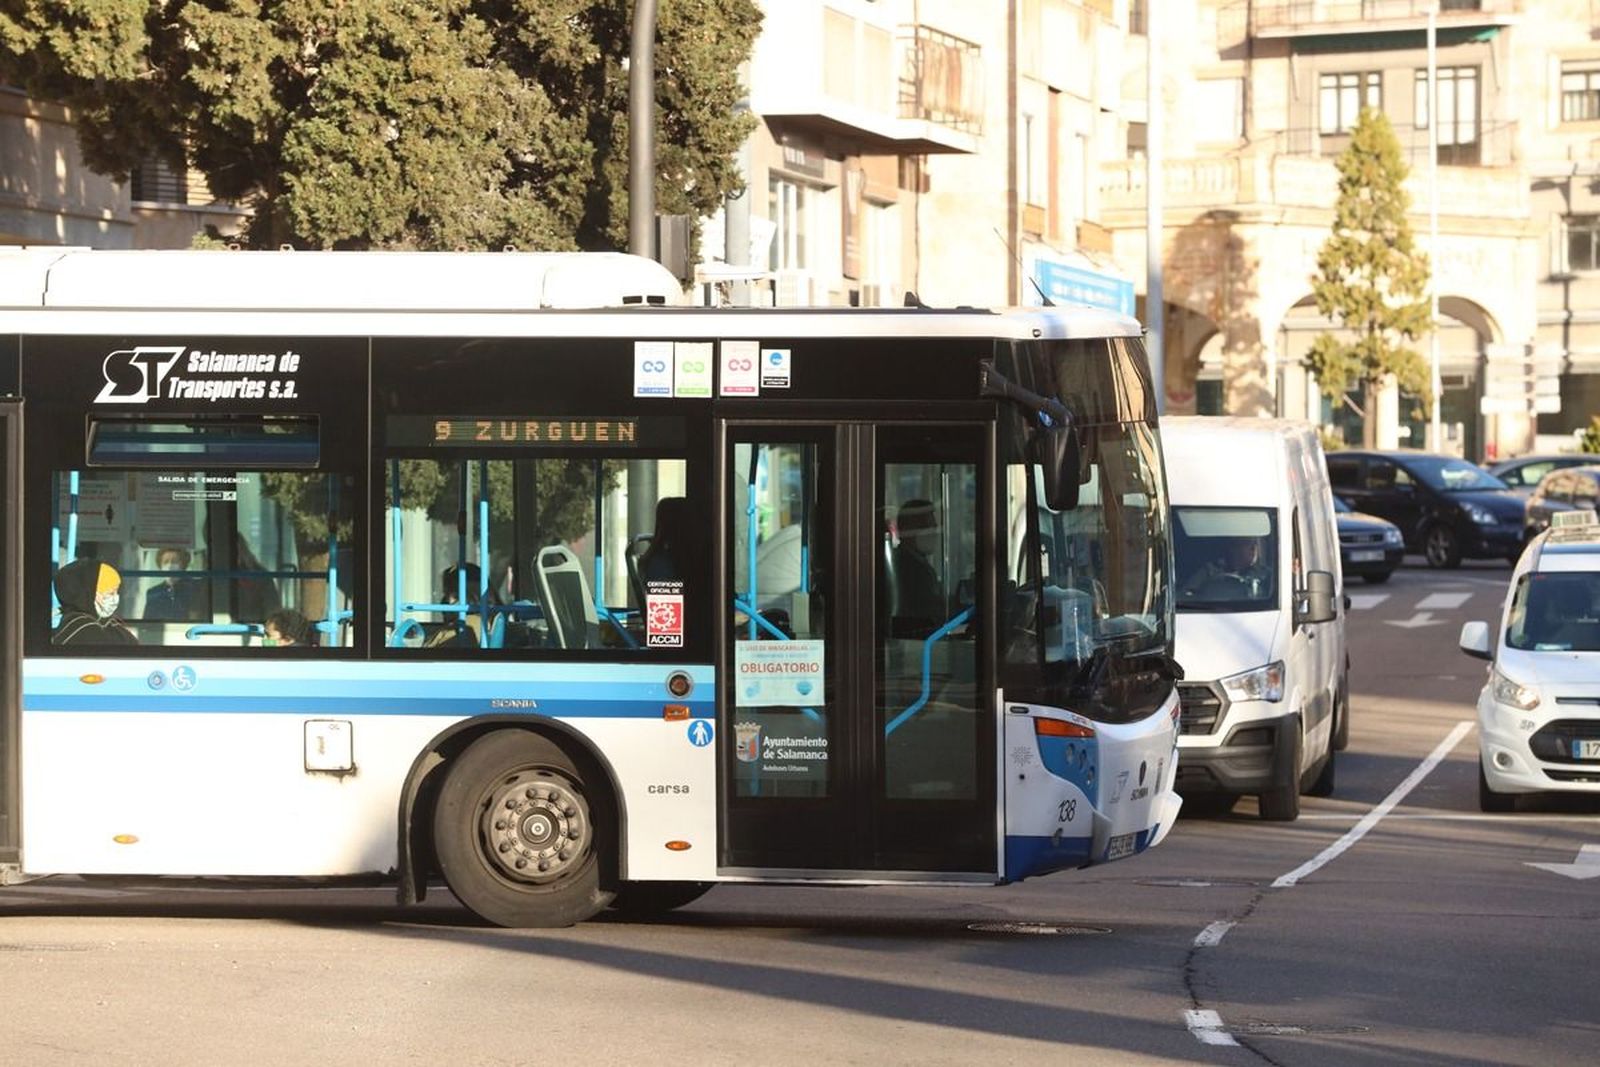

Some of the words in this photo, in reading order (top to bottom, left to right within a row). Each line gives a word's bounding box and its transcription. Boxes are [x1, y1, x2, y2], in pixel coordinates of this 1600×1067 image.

[187, 351, 276, 373] Salamanca
[279, 351, 300, 372] de
[93, 347, 187, 403] ST
[168, 377, 266, 402] Transportes
[269, 384, 298, 398] s.a.
[435, 420, 451, 441] 9
[475, 421, 635, 441] ZURGUEN
[651, 635, 680, 644] ACCM
[740, 662, 820, 673] OBLIGATORIO
[491, 699, 537, 708] SCANIA
[763, 736, 828, 748] Ayuntamiento
[763, 749, 775, 759] de
[777, 749, 828, 759] Salamanca
[648, 785, 690, 794] carsa
[1058, 799, 1077, 822] 138
